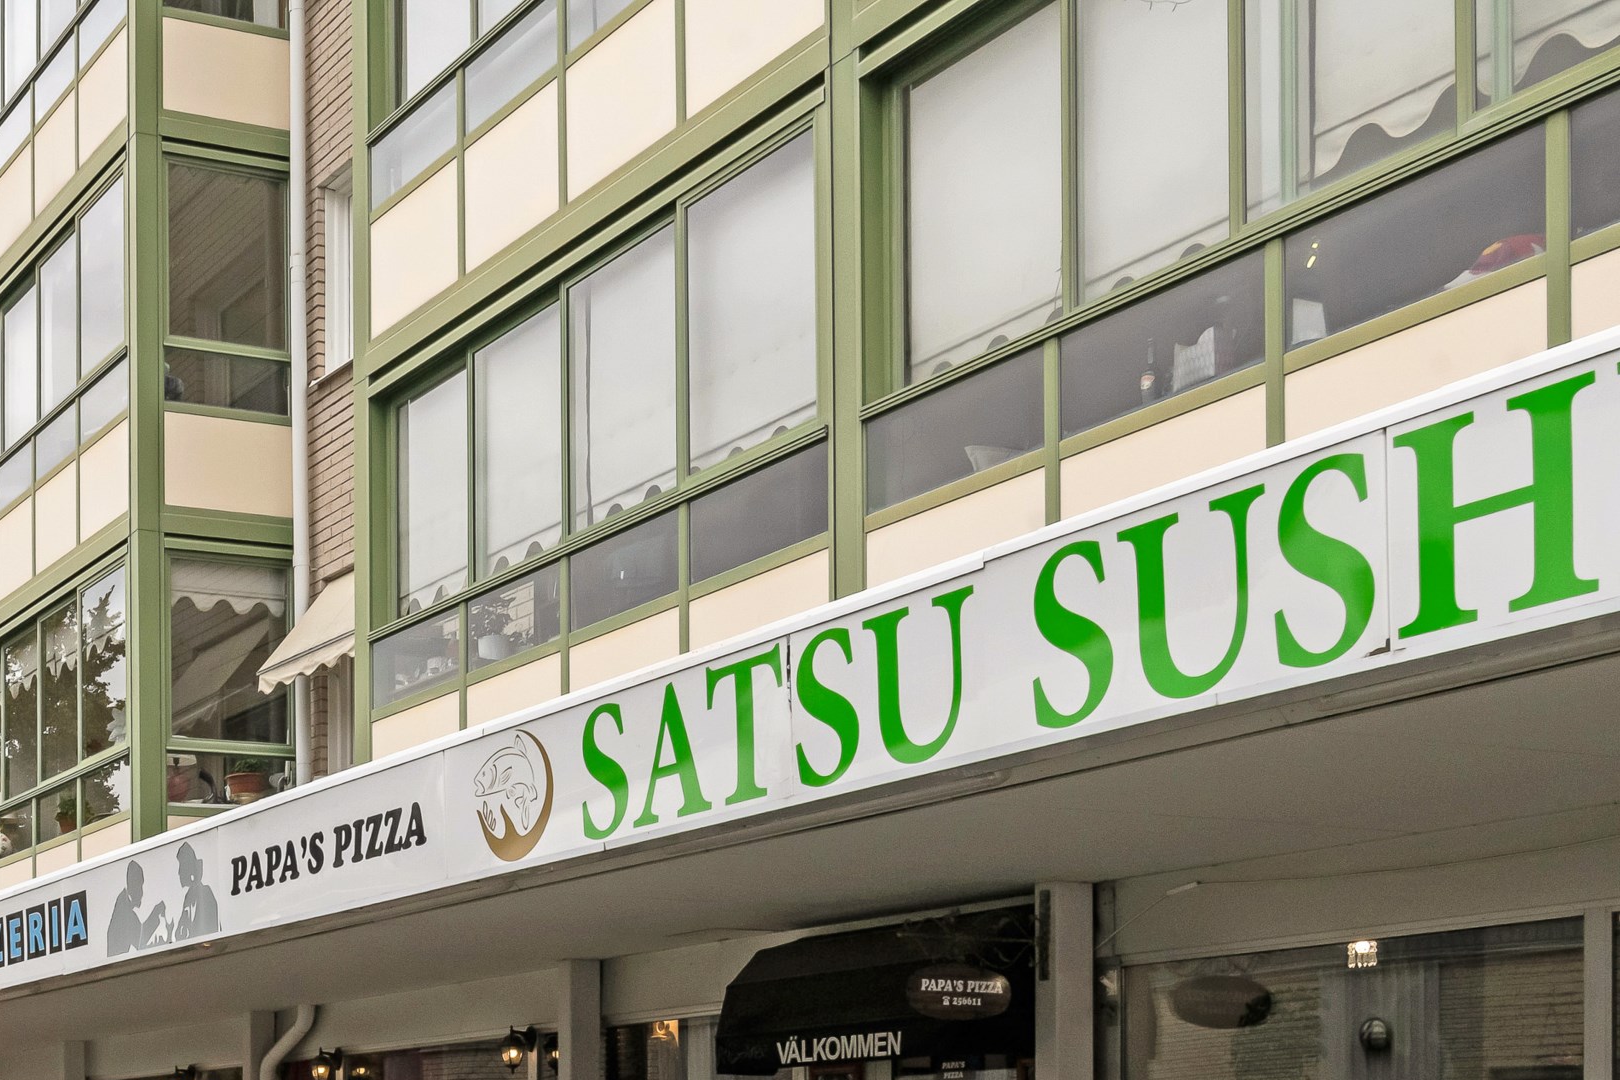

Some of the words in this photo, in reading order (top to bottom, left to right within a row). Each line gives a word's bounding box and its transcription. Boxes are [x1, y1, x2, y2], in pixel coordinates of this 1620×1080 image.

[582, 585, 974, 841] SATSU
[1033, 361, 1620, 729] SUSH
[230, 831, 324, 896] PAPA'S
[332, 802, 427, 868] PIZZA
[920, 978, 964, 992] PAPA'S
[966, 980, 1003, 994] PIZZA
[776, 1031, 902, 1065] VÄLKOMMEN
[942, 1061, 965, 1070] PAPA'S
[943, 1071, 964, 1080] PIZZA
